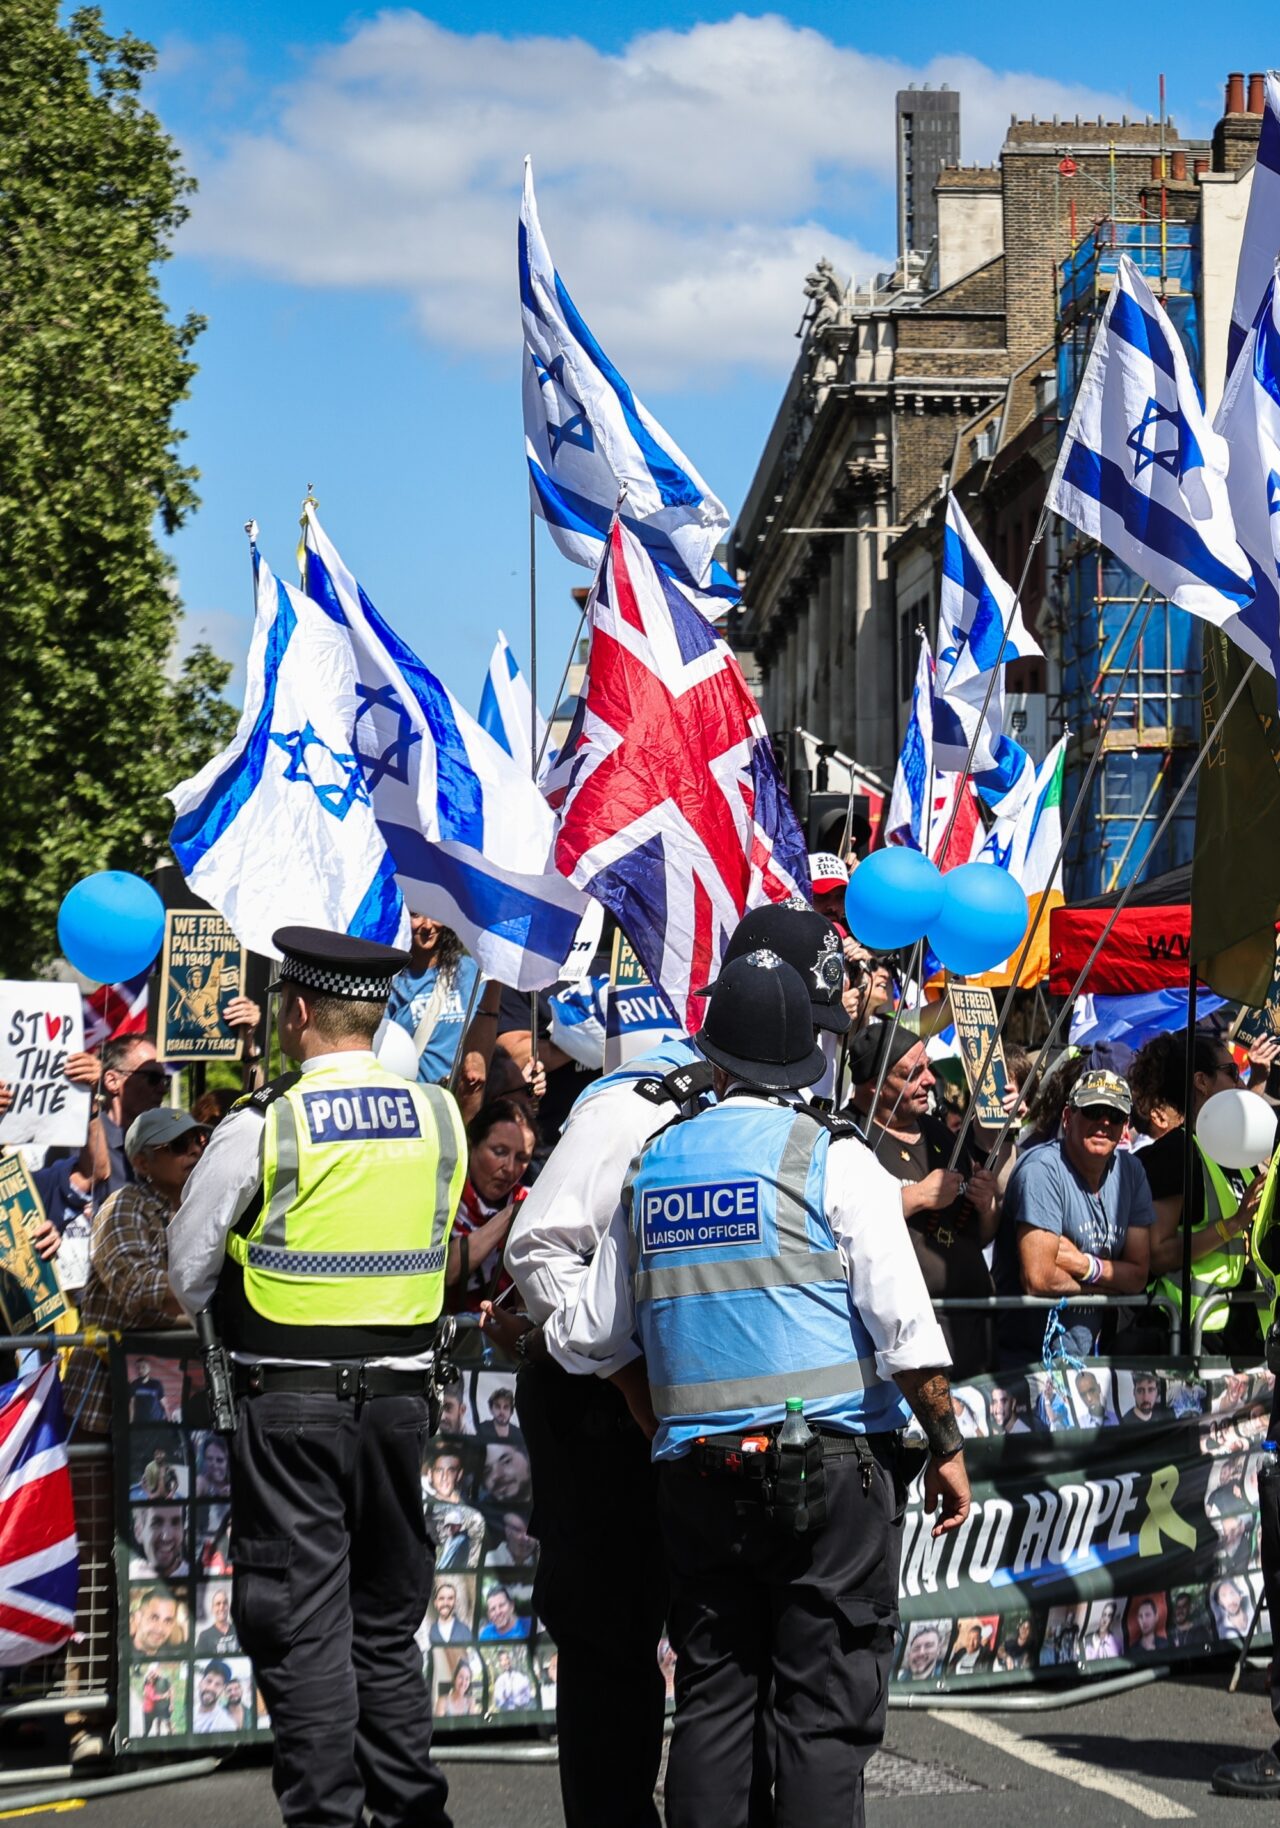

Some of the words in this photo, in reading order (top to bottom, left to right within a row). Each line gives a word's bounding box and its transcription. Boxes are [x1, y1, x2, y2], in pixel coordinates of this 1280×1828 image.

[174, 917, 197, 934] WE
[200, 917, 234, 934] FREE
[172, 935, 241, 952] PALESTINE
[171, 952, 183, 966] IN
[185, 952, 212, 967] 1948
[952, 991, 964, 1008] WE
[964, 992, 991, 1009] FREED
[955, 1008, 995, 1025] PALESTINE
[963, 1025, 980, 1039] 1948
[166, 1038, 194, 1051] ISRAEL
[195, 1038, 207, 1050] 77
[208, 1038, 236, 1050] YEARS
[16, 1047, 68, 1080] THE
[310, 1096, 415, 1134] POLICE
[646, 1187, 756, 1224] POLICE
[646, 1228, 695, 1246] LIAISON
[698, 1223, 757, 1240] OFFICER
[1013, 1472, 1141, 1575] HOPE
